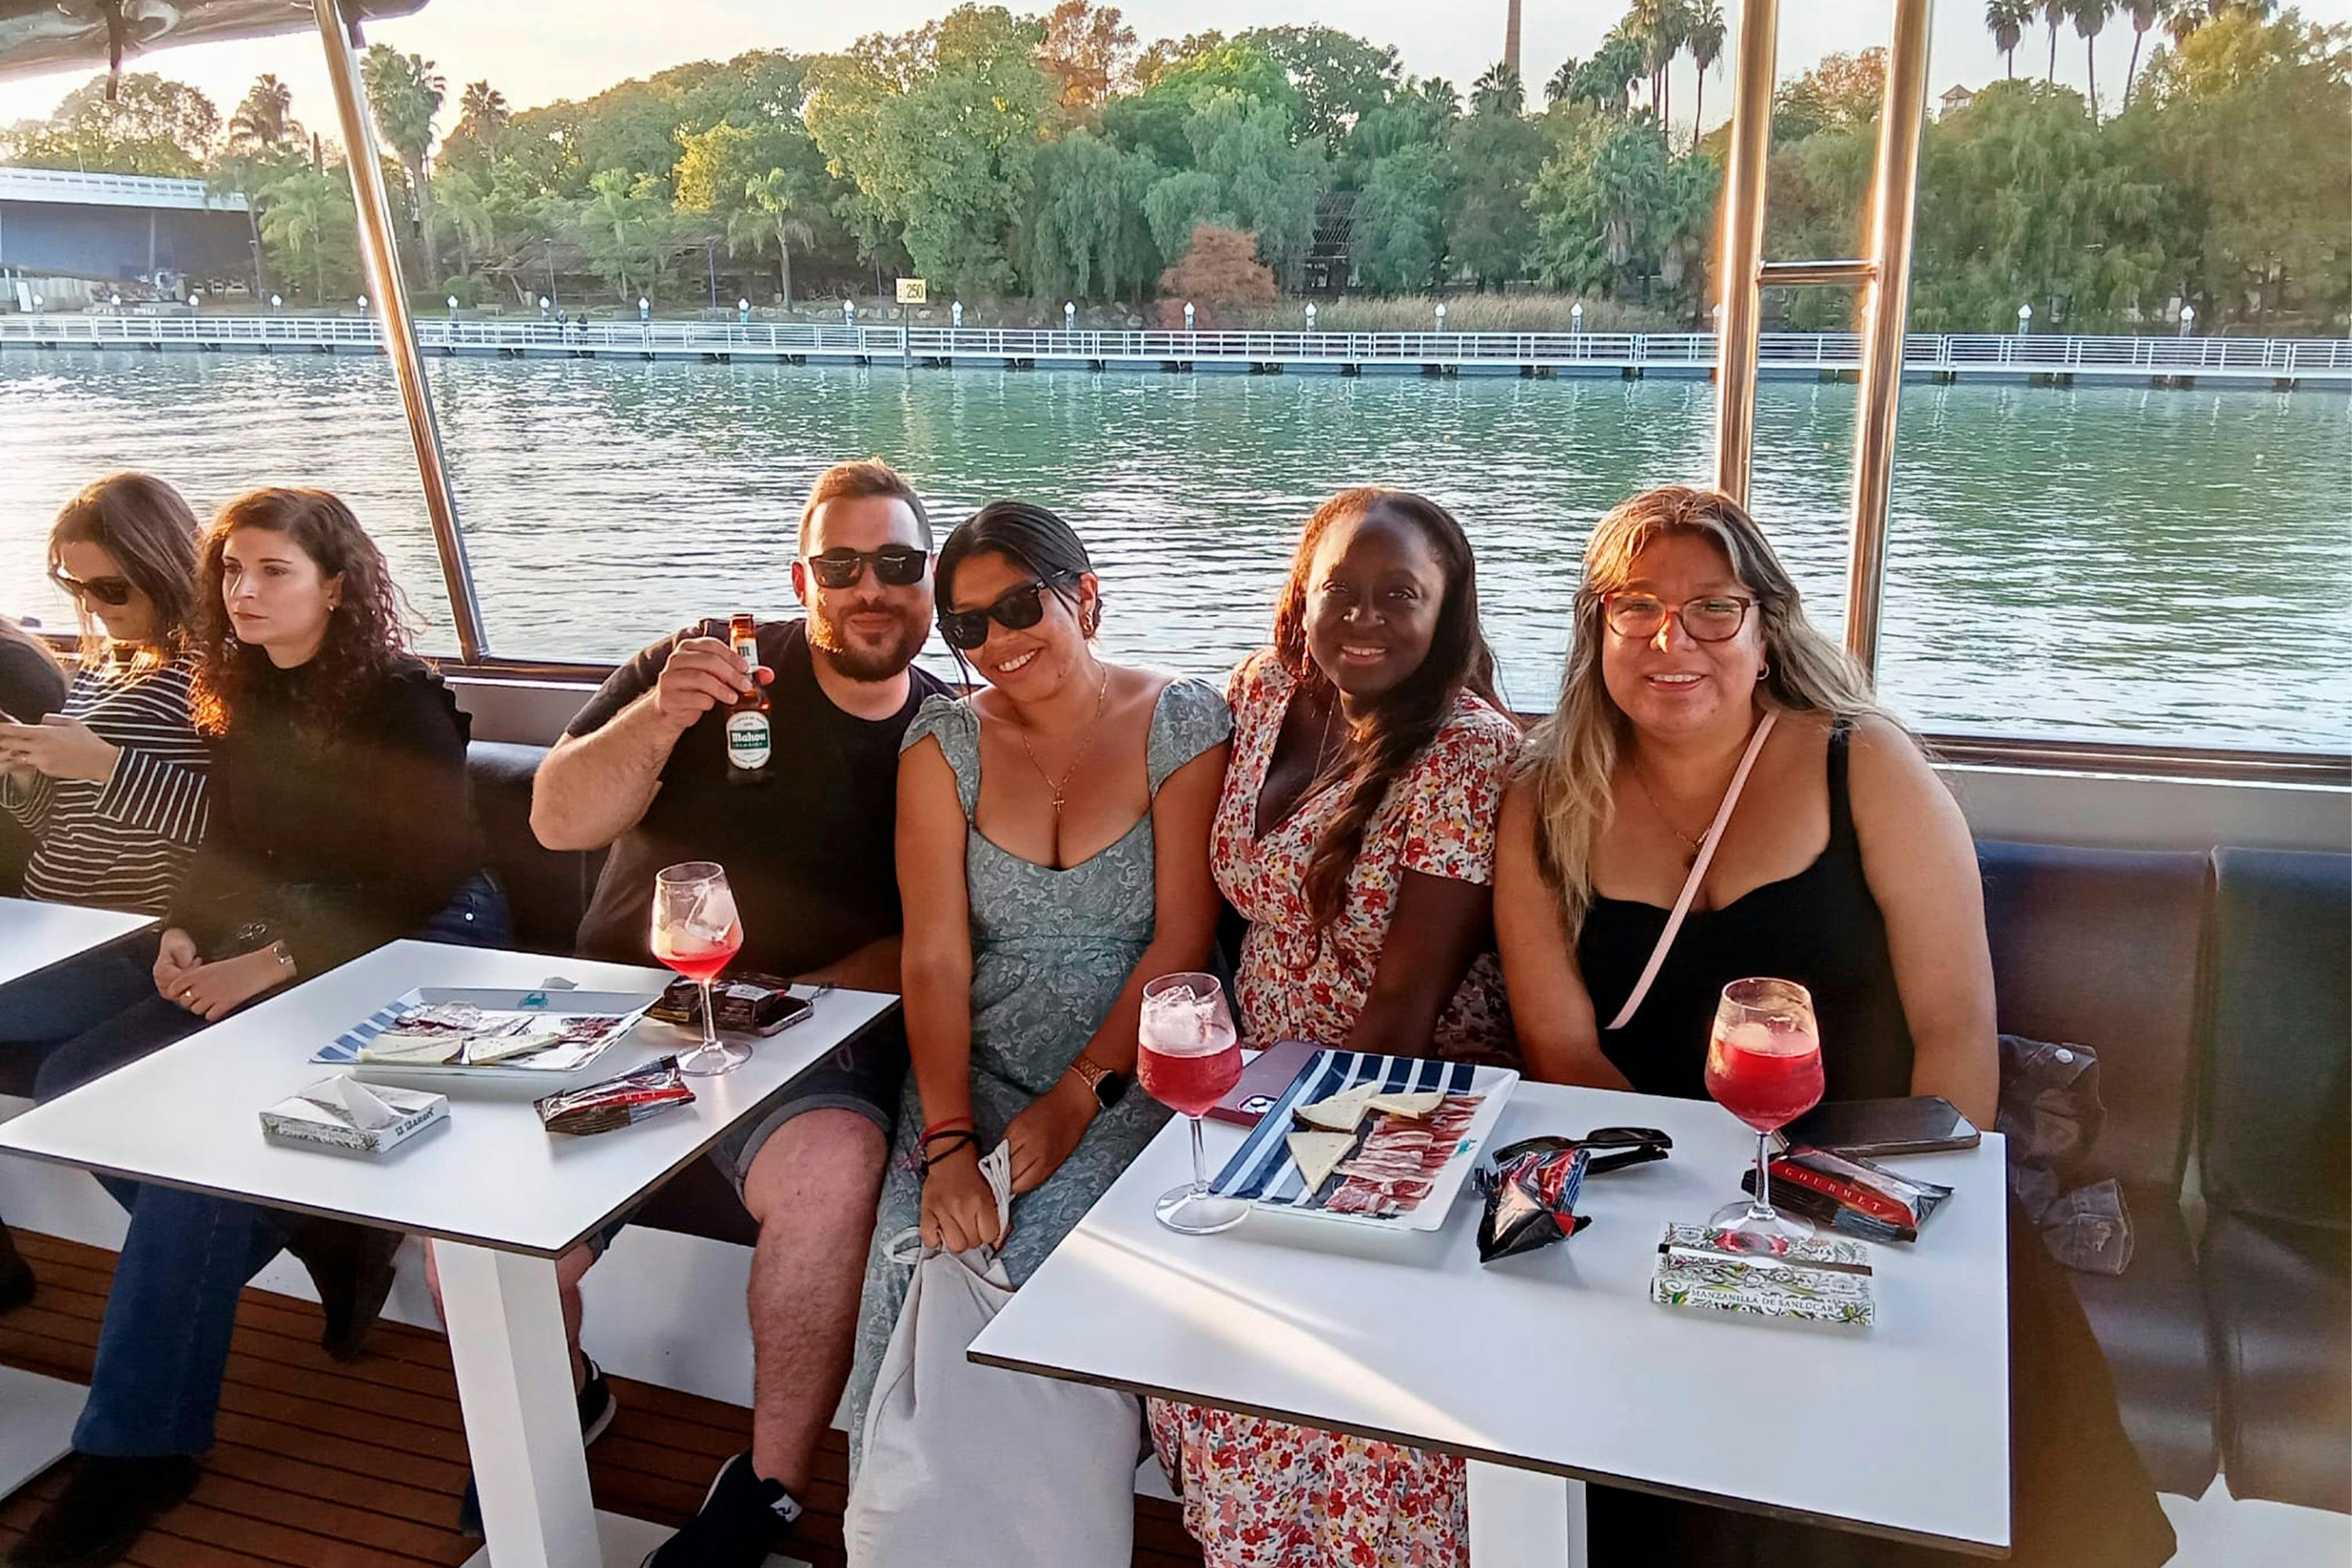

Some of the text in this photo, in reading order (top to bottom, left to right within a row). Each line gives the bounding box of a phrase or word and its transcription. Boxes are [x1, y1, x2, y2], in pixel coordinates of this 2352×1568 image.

[906, 284, 924, 298] 250
[731, 731, 766, 742] Mahou
[1784, 1167, 1881, 1210] GOURMET
[1691, 1289, 1759, 1304] MANZANILLA
[1762, 1297, 1776, 1306] DE
